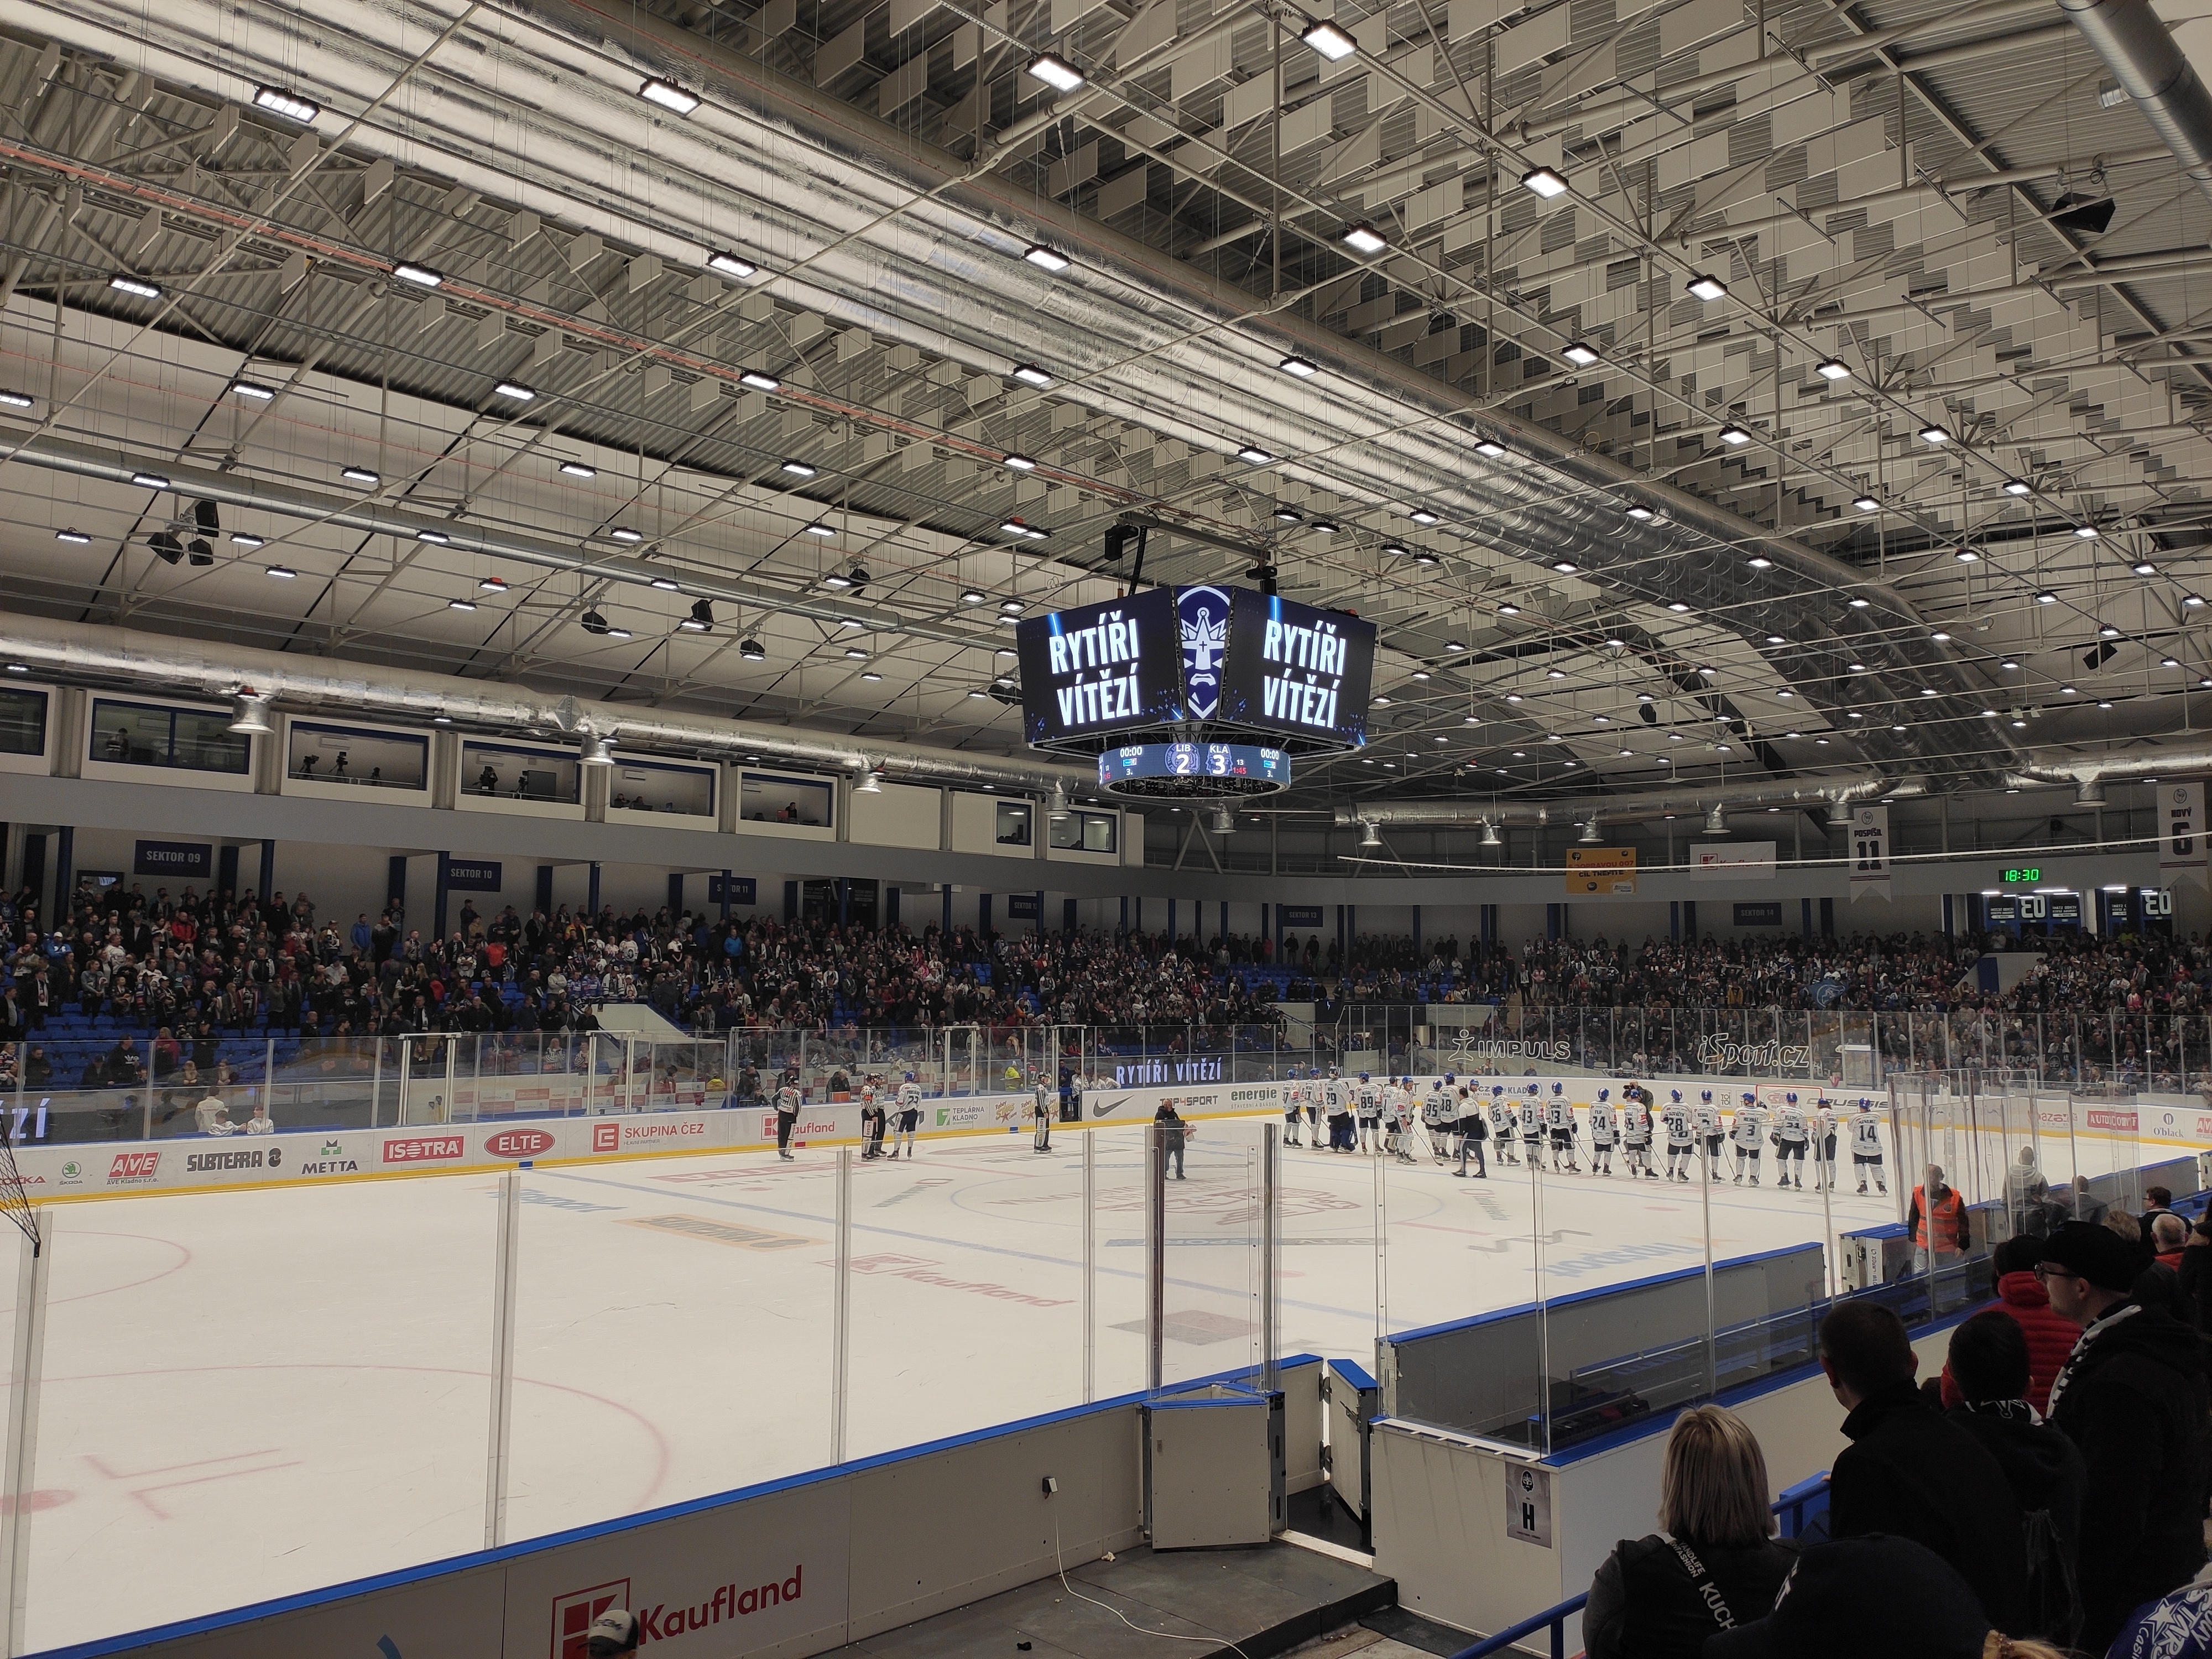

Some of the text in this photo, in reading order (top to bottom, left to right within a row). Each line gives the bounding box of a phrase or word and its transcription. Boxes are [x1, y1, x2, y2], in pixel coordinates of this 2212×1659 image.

[1049, 609, 1139, 675] RYTÍŘI
[1263, 618, 1347, 676] RYTÍŘI
[1057, 662, 1141, 726] VÍTĚZÍ
[1263, 668, 1340, 728] VÍTĚZÍ
[1120, 746, 1142, 758] 00:00
[1176, 744, 1191, 753] LIB
[1209, 745, 1229, 754] KLA
[1260, 748, 1279, 760] 00:00
[1176, 753, 1190, 774] 2
[1212, 754, 1226, 775] 3
[2171, 806, 2192, 818] NOVÝ
[1854, 827, 1882, 837] POSPÍŠIL
[2172, 822, 2193, 855] 6
[146, 851, 200, 863] SEKTOR 09
[1856, 841, 1882, 870] 11
[451, 868, 492, 879] SEKTOR 10
[2005, 869, 2039, 882] 18:30
[1478, 1040, 1571, 1060] IMPULS
[1697, 1032, 1809, 1071] iSport.cz
[1116, 1057, 1222, 1084] RYTÍŘI VÍTĚZÍ
[1160, 1095, 1218, 1106] TP4SPORT
[1231, 1087, 1277, 1101] energie
[953, 1106, 984, 1114] TEPLÁRNA
[1360, 1096, 1373, 1109] 89
[0, 1098, 50, 1139] ZÍ
[1593, 1115, 1606, 1130] 24
[1668, 1118, 1683, 1131] 28
[624, 1121, 704, 1138] SKUPINA ČEZ
[795, 1120, 835, 1134] aufland
[1859, 1125, 1877, 1142] 14
[2153, 1126, 2184, 1138] O'black
[388, 1140, 458, 1160] ISOTRA
[498, 1135, 541, 1151] ELTE
[111, 1157, 156, 1173] AVE
[186, 1151, 263, 1172] SUBTERRA
[301, 1160, 358, 1175] METTA
[0, 1175, 46, 1185] OČKA
[892, 1269, 1079, 1307] Kaufland
[1522, 1502, 1535, 1531] H
[639, 1565, 802, 1646] Kaufland
